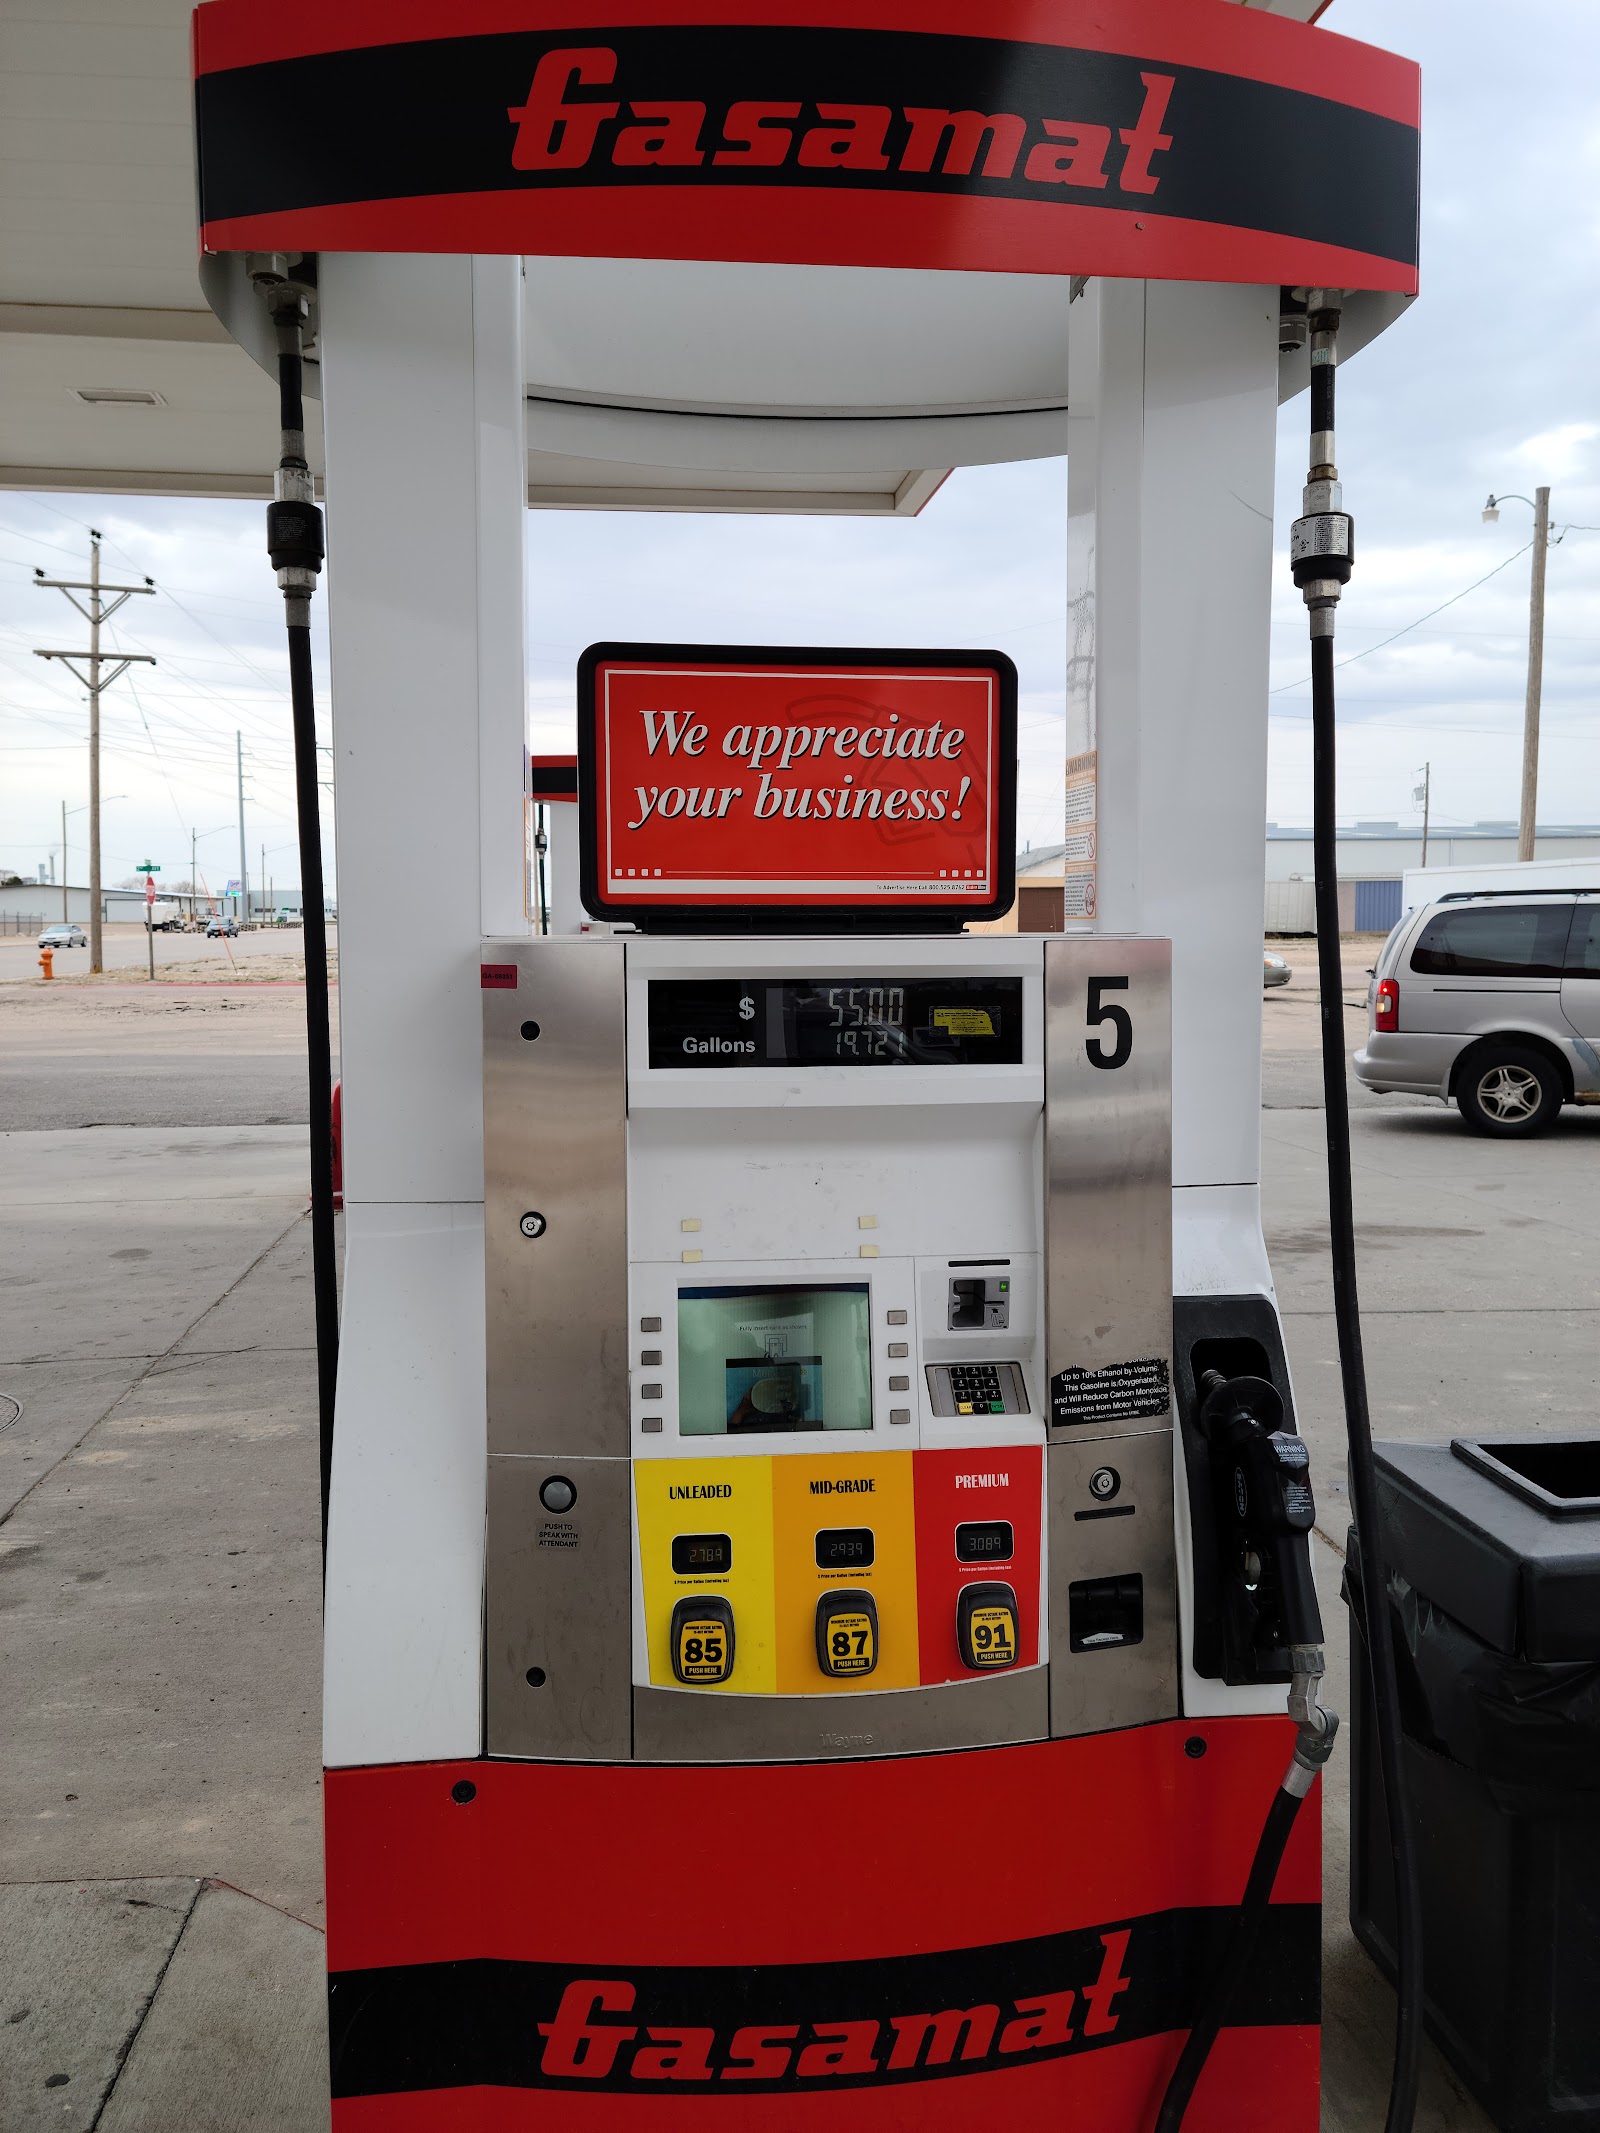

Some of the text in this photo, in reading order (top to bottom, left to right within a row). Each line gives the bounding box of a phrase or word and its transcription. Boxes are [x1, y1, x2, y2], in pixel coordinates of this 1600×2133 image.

[507, 47, 1176, 195] Gasamat
[639, 710, 966, 770] We appreciate
[627, 772, 972, 830] your business!
[738, 996, 756, 1021] $
[829, 988, 904, 1027] 55.00
[1086, 976, 1132, 1069] 5
[682, 1036, 756, 1054] Gallons
[1061, 1373, 1072, 1382] Up
[1081, 1370, 1097, 1379] 10%
[1097, 1368, 1123, 1378] Ethanol
[1124, 1366, 1133, 1376] by
[1054, 1385, 1168, 1405] and Will Reduce Carbon Monoxide
[1064, 1383, 1079, 1392] This
[1080, 1380, 1110, 1391] Gasoline
[1110, 1379, 1117, 1388] is
[1060, 1404, 1095, 1415] Emissions
[1095, 1403, 1112, 1411] from
[1112, 1401, 1133, 1409] Motor
[1274, 1445, 1306, 1453] WARNING
[809, 1479, 877, 1495] MID-GRADE
[955, 1473, 1010, 1489] PREMIUM
[669, 1484, 732, 1500] UNLEADED
[538, 1540, 578, 1548] ATTENDANT
[832, 1630, 868, 1657] 87
[974, 1623, 1012, 1650] 91
[684, 1638, 723, 1663] 85
[820, 1733, 874, 1749] Wayne
[537, 1928, 1132, 2080] Gasamat
